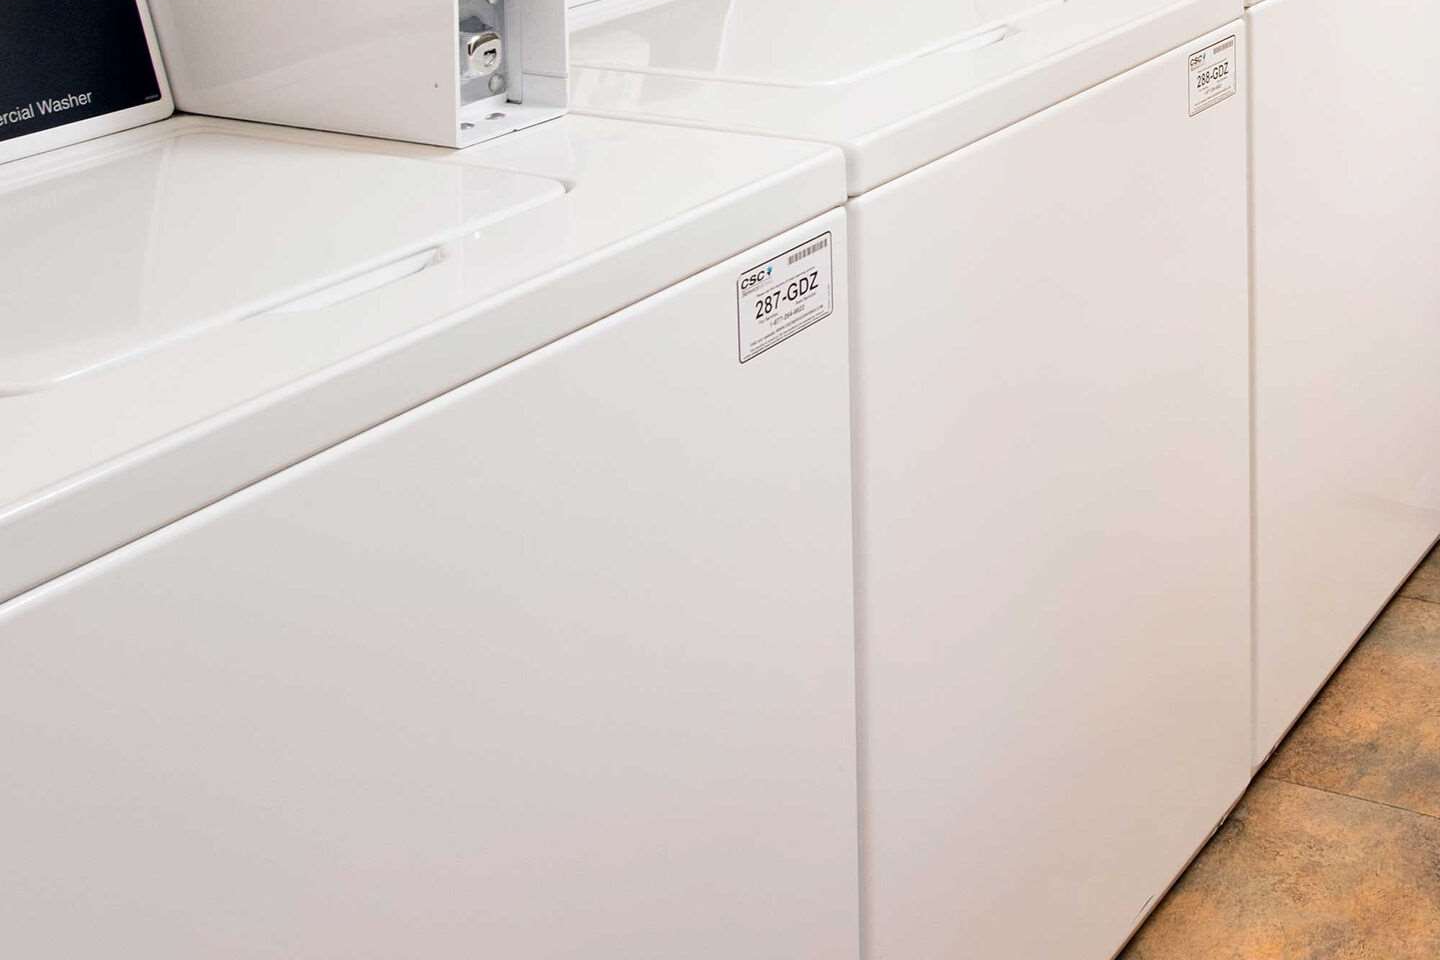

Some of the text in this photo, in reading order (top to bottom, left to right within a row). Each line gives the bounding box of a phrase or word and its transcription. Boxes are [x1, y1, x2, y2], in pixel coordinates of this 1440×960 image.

[1196, 61, 1229, 89] 288-GDZ
[36, 91, 93, 116] Washer
[740, 270, 766, 290] CSC
[755, 271, 819, 320] 287-GDZ
